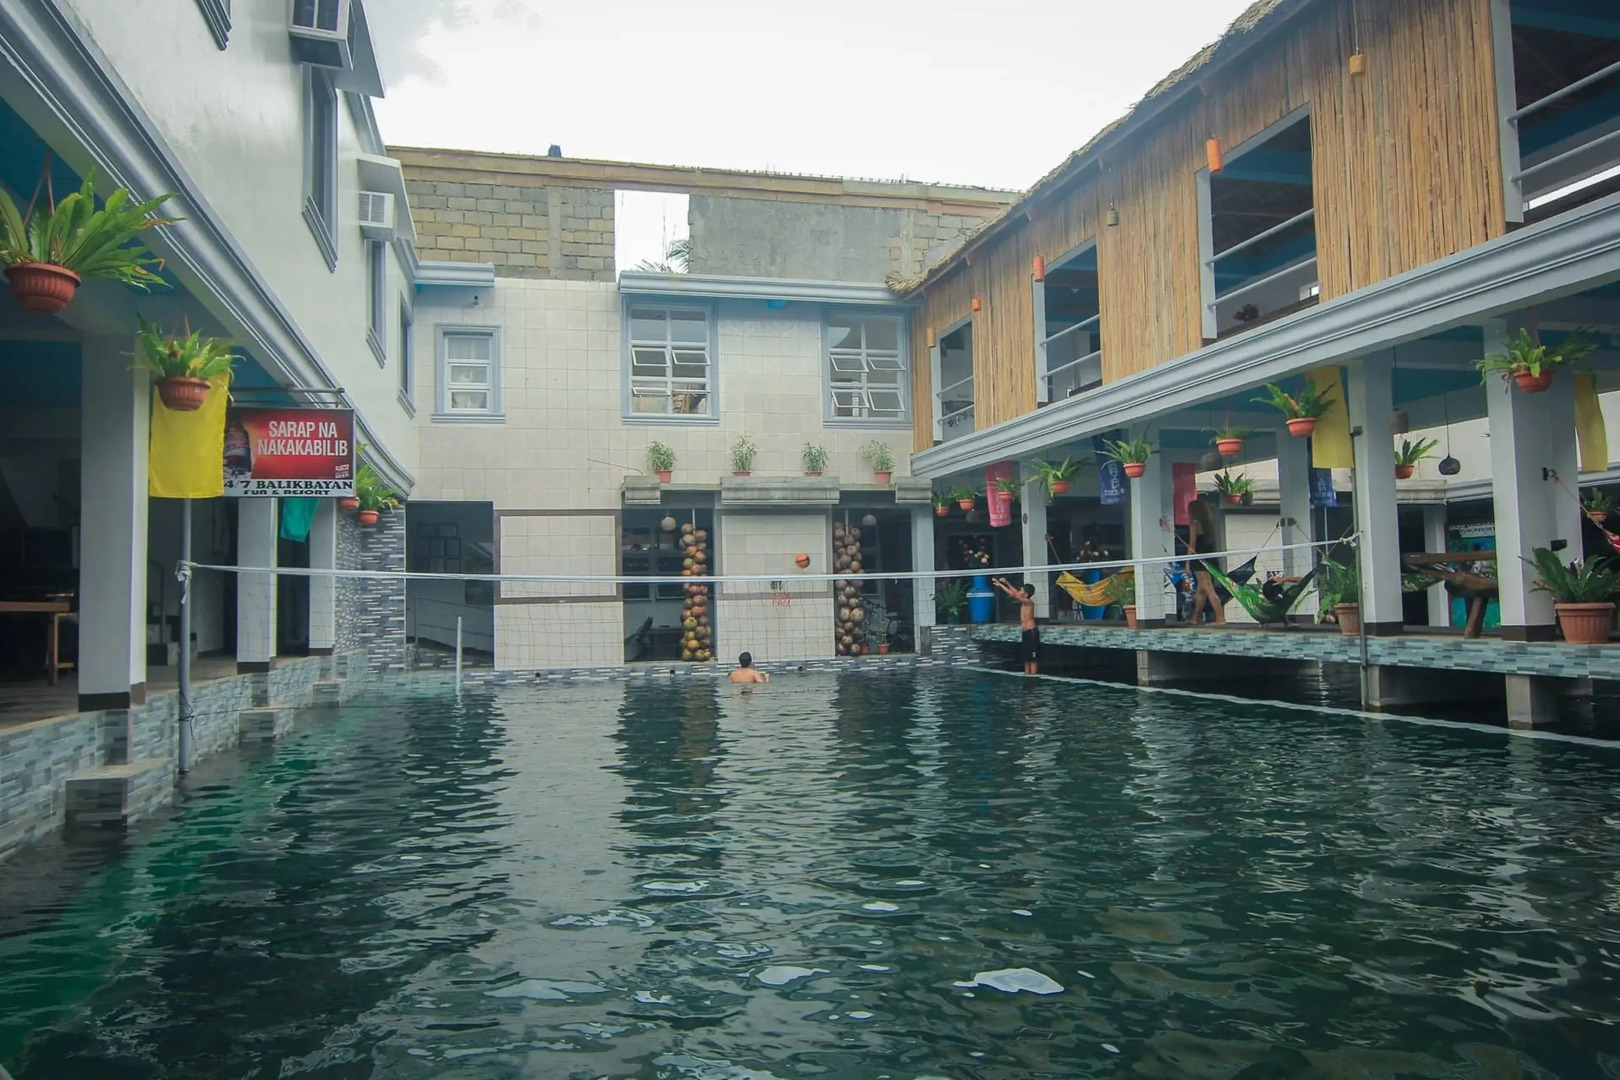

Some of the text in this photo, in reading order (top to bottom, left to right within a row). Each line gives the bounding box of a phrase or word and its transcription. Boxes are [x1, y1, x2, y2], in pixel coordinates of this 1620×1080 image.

[269, 421, 337, 438] SARAP NA
[258, 440, 348, 456] NAKAKABILIB
[224, 480, 353, 489] 4/7 BALIKBAYAN
